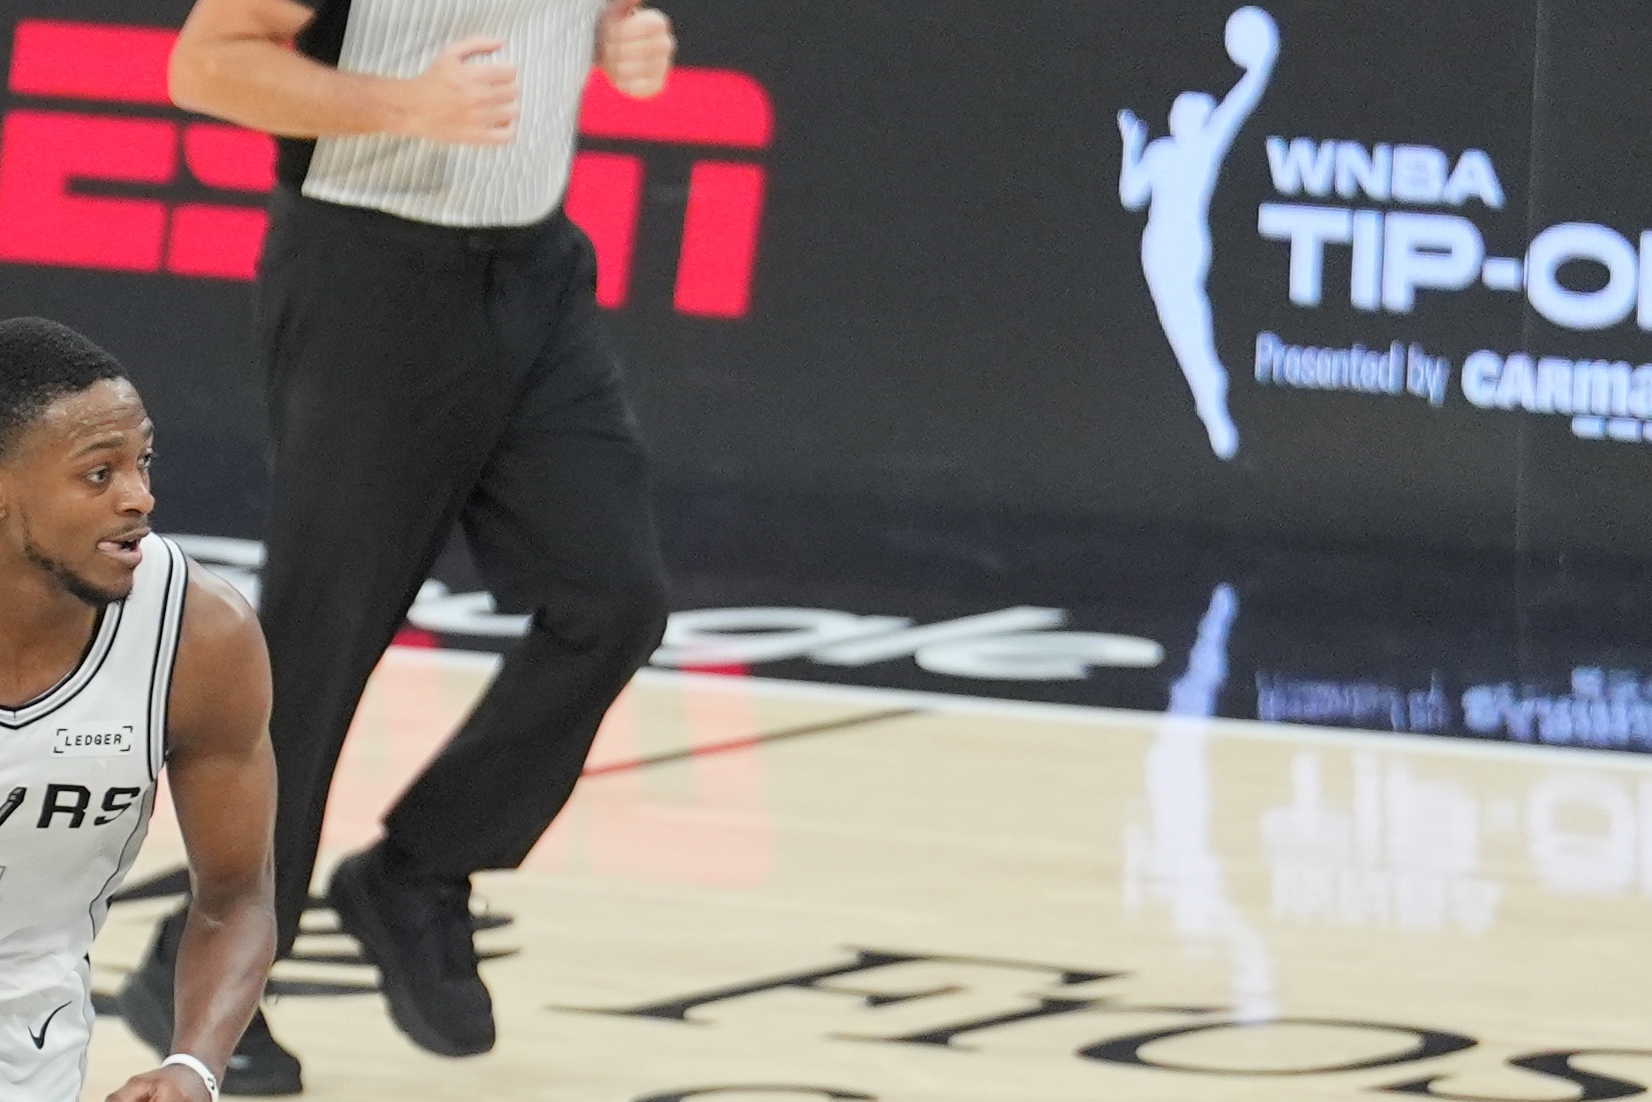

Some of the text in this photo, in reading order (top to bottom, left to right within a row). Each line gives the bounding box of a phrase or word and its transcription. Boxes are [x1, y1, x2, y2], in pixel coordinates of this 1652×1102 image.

[1265, 135, 1506, 209] WNBA
[1257, 203, 1652, 332] TIP-O
[64, 732, 123, 747] LEDGER
